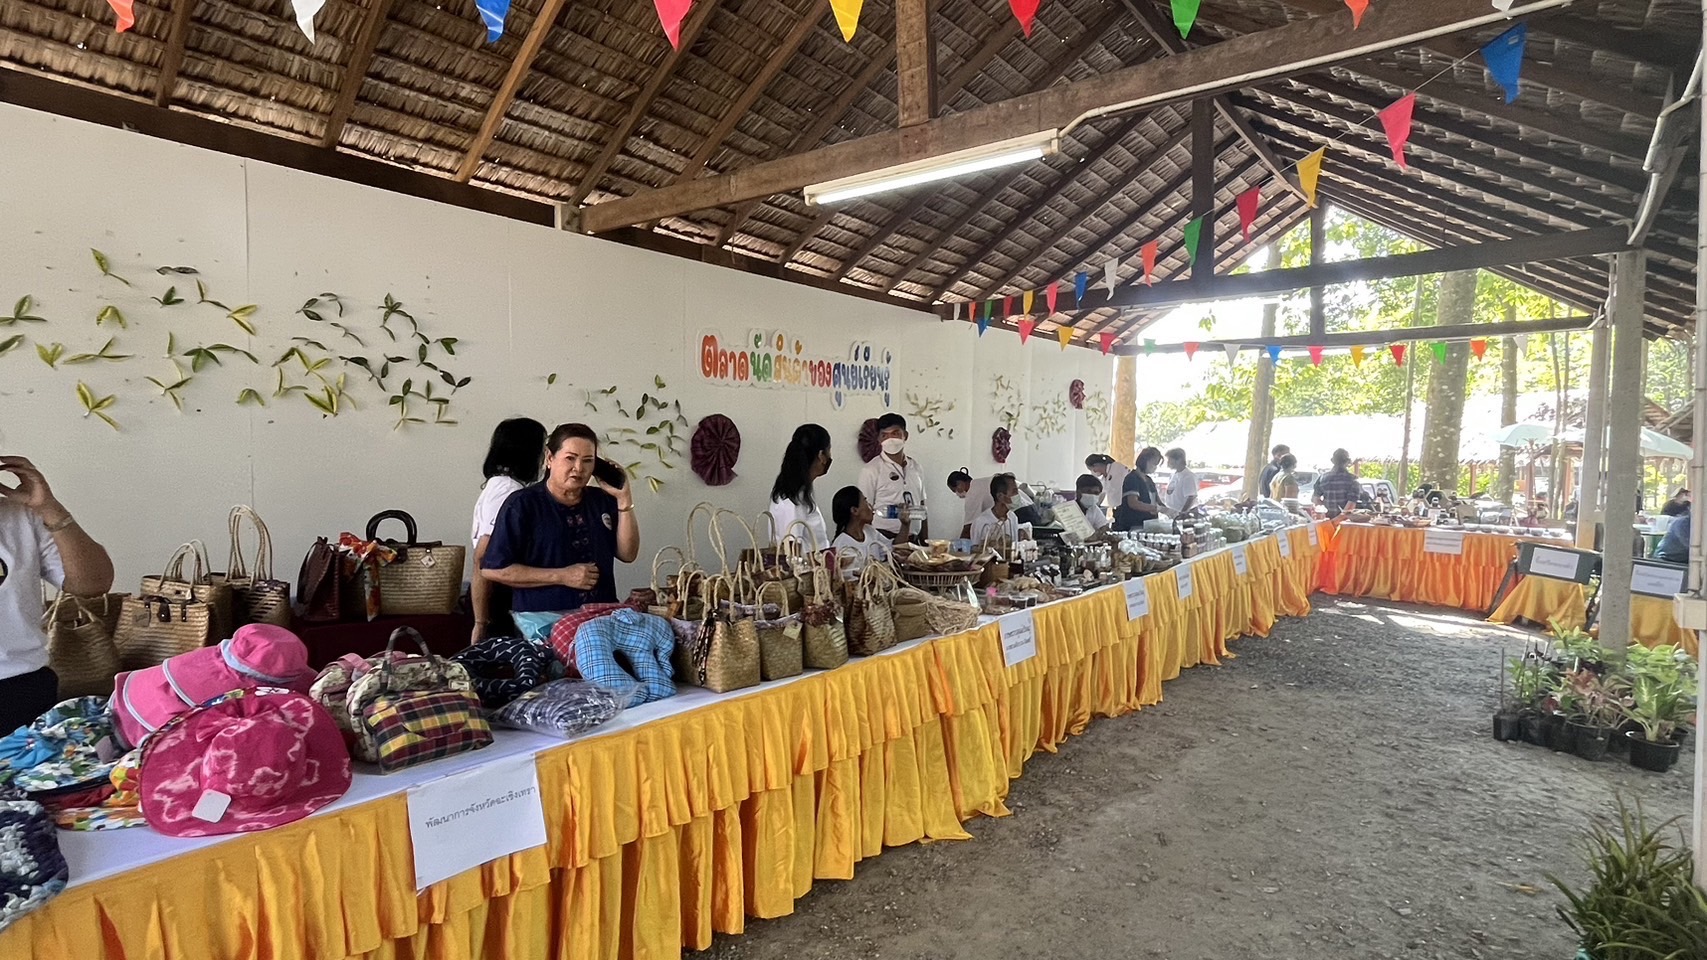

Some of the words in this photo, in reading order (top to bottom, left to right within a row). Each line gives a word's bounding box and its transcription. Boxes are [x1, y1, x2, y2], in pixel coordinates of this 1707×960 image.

[425, 786, 536, 828] พัฒนาการจังหวัดฉะเชิงเทรา
